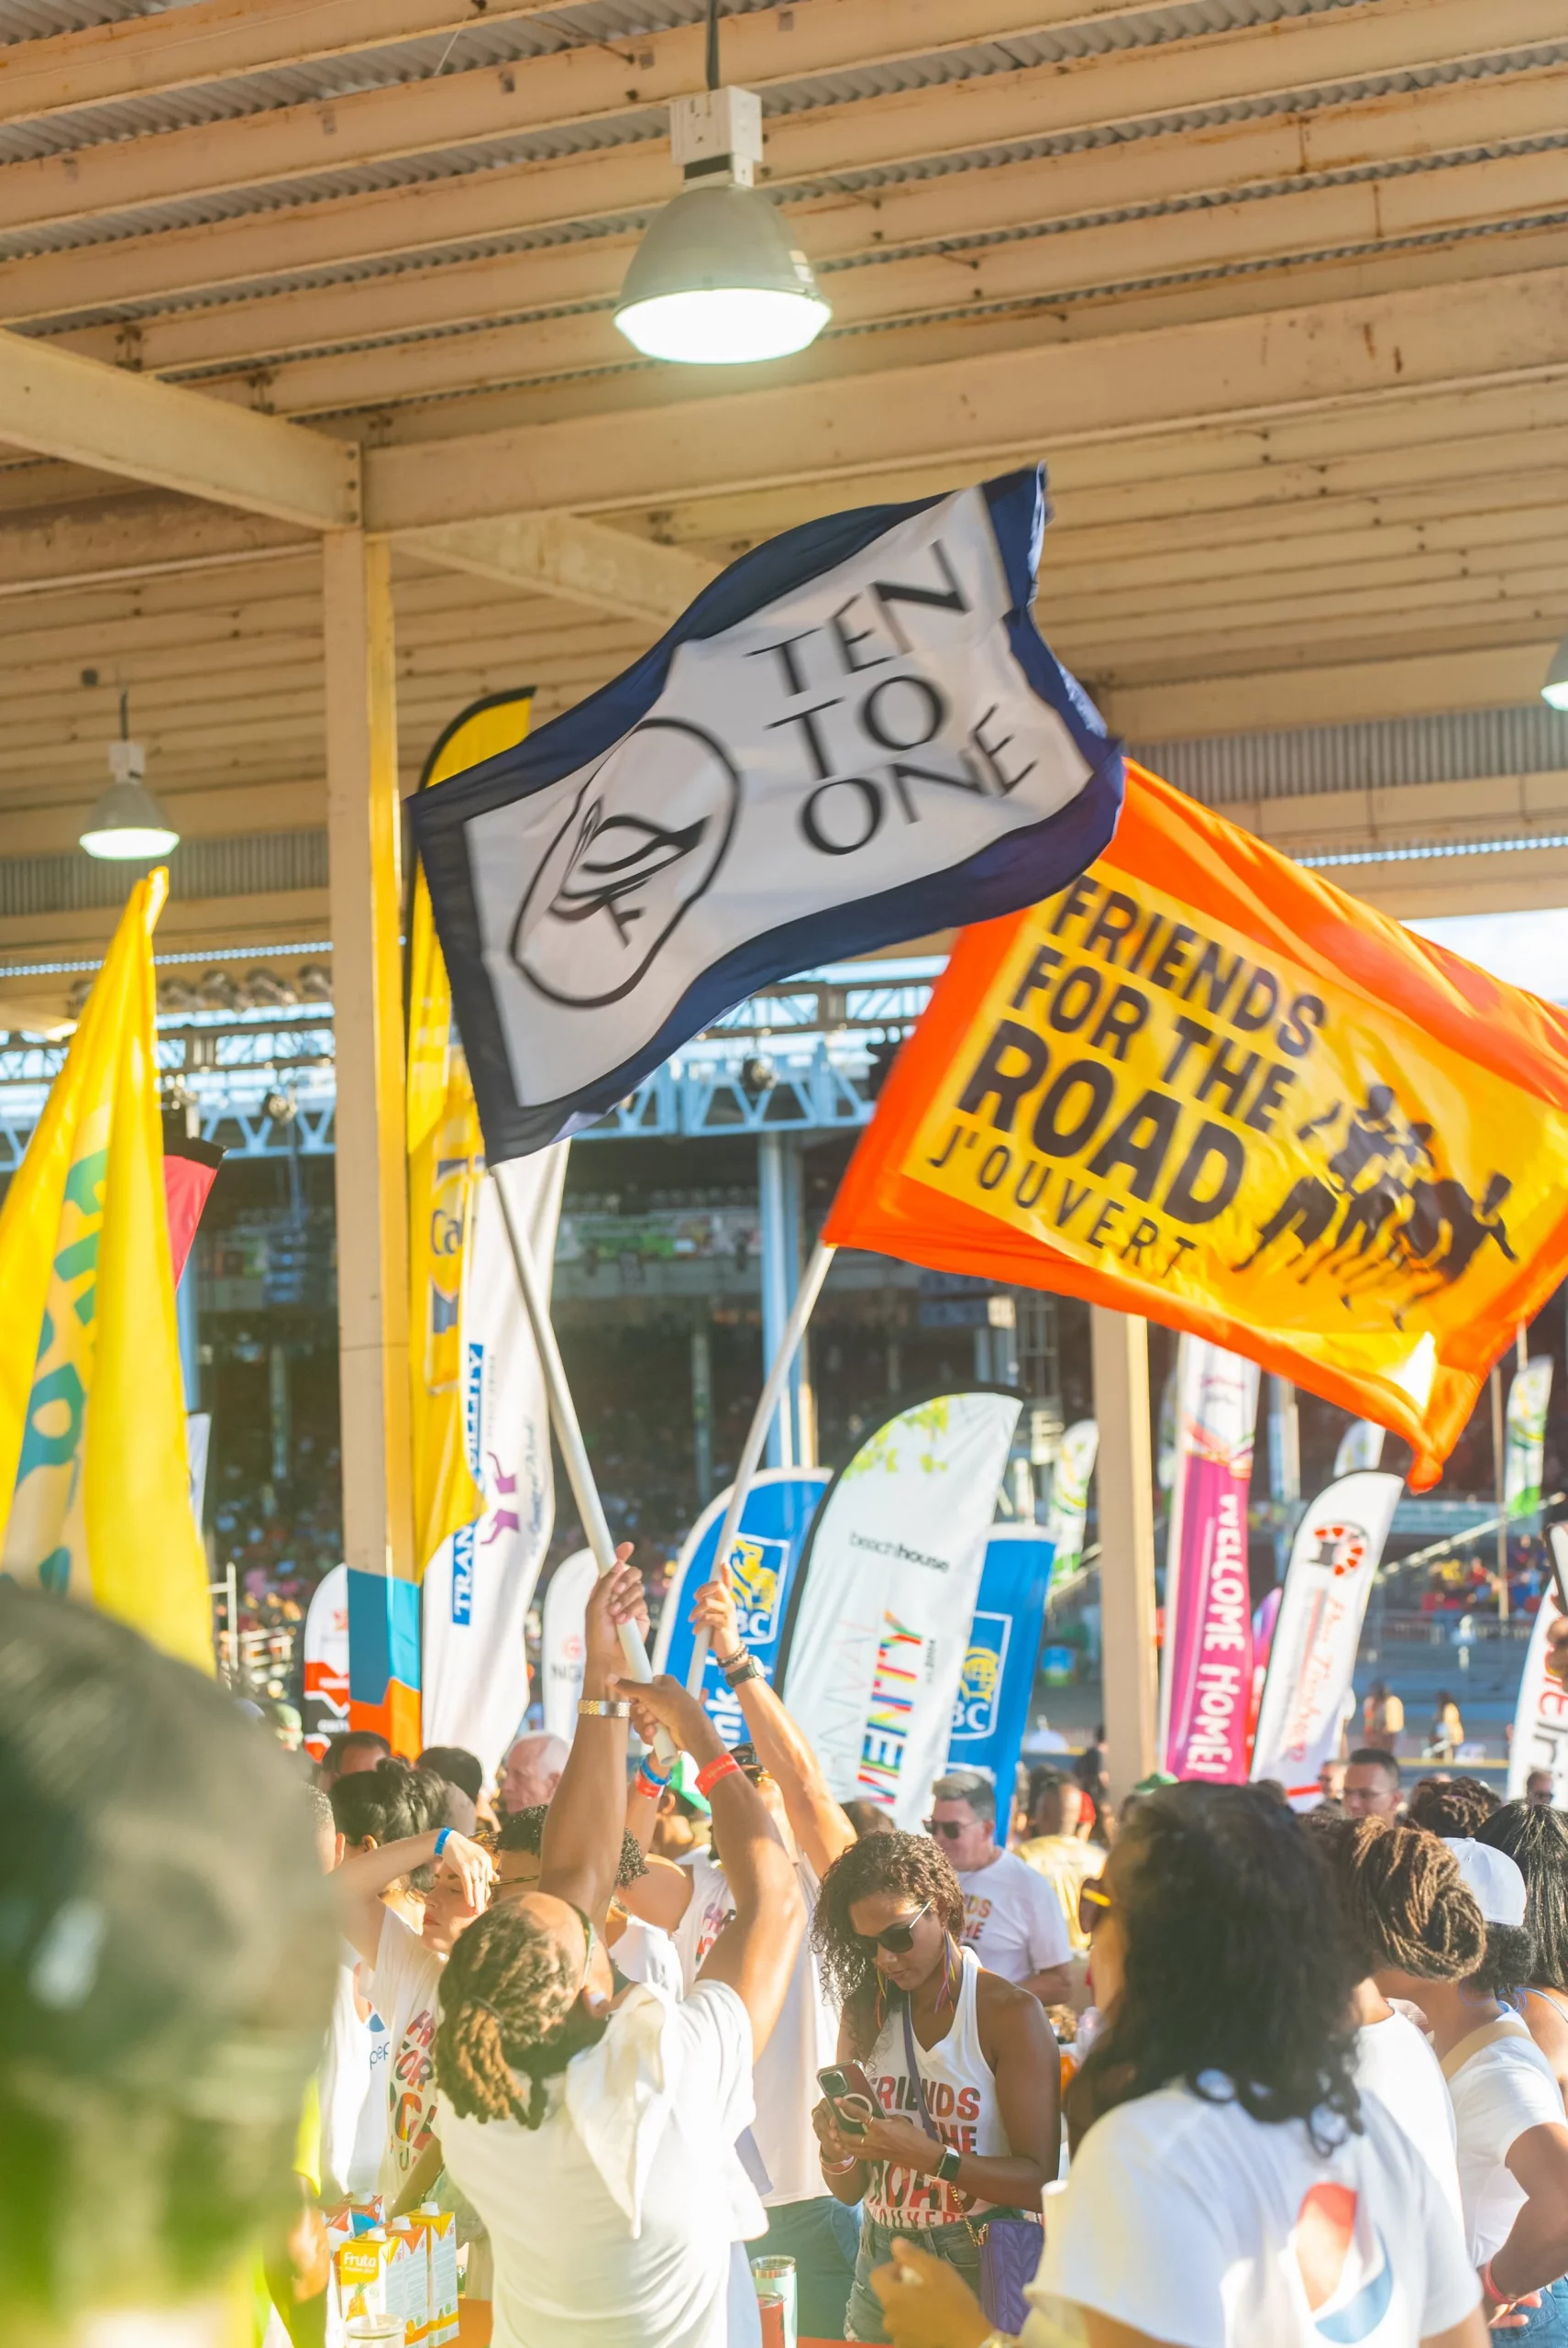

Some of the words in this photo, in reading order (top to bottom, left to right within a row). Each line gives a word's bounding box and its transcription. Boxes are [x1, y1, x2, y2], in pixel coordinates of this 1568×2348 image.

[742, 538, 972, 697] TEN
[763, 675, 948, 781] TO
[799, 703, 1039, 856] ONE
[1007, 943, 1149, 1062] FOR
[1160, 1013, 1297, 1133] THE
[1049, 874, 1327, 1058] FRIENDS
[955, 1018, 1245, 1224] ROAD
[927, 1124, 1197, 1279] J'OUVERT
[735, 1609, 769, 1637] BC
[952, 1700, 989, 1732] BC
[1187, 1663, 1239, 1775] HOME!
[344, 2251, 377, 2268] Fruta
